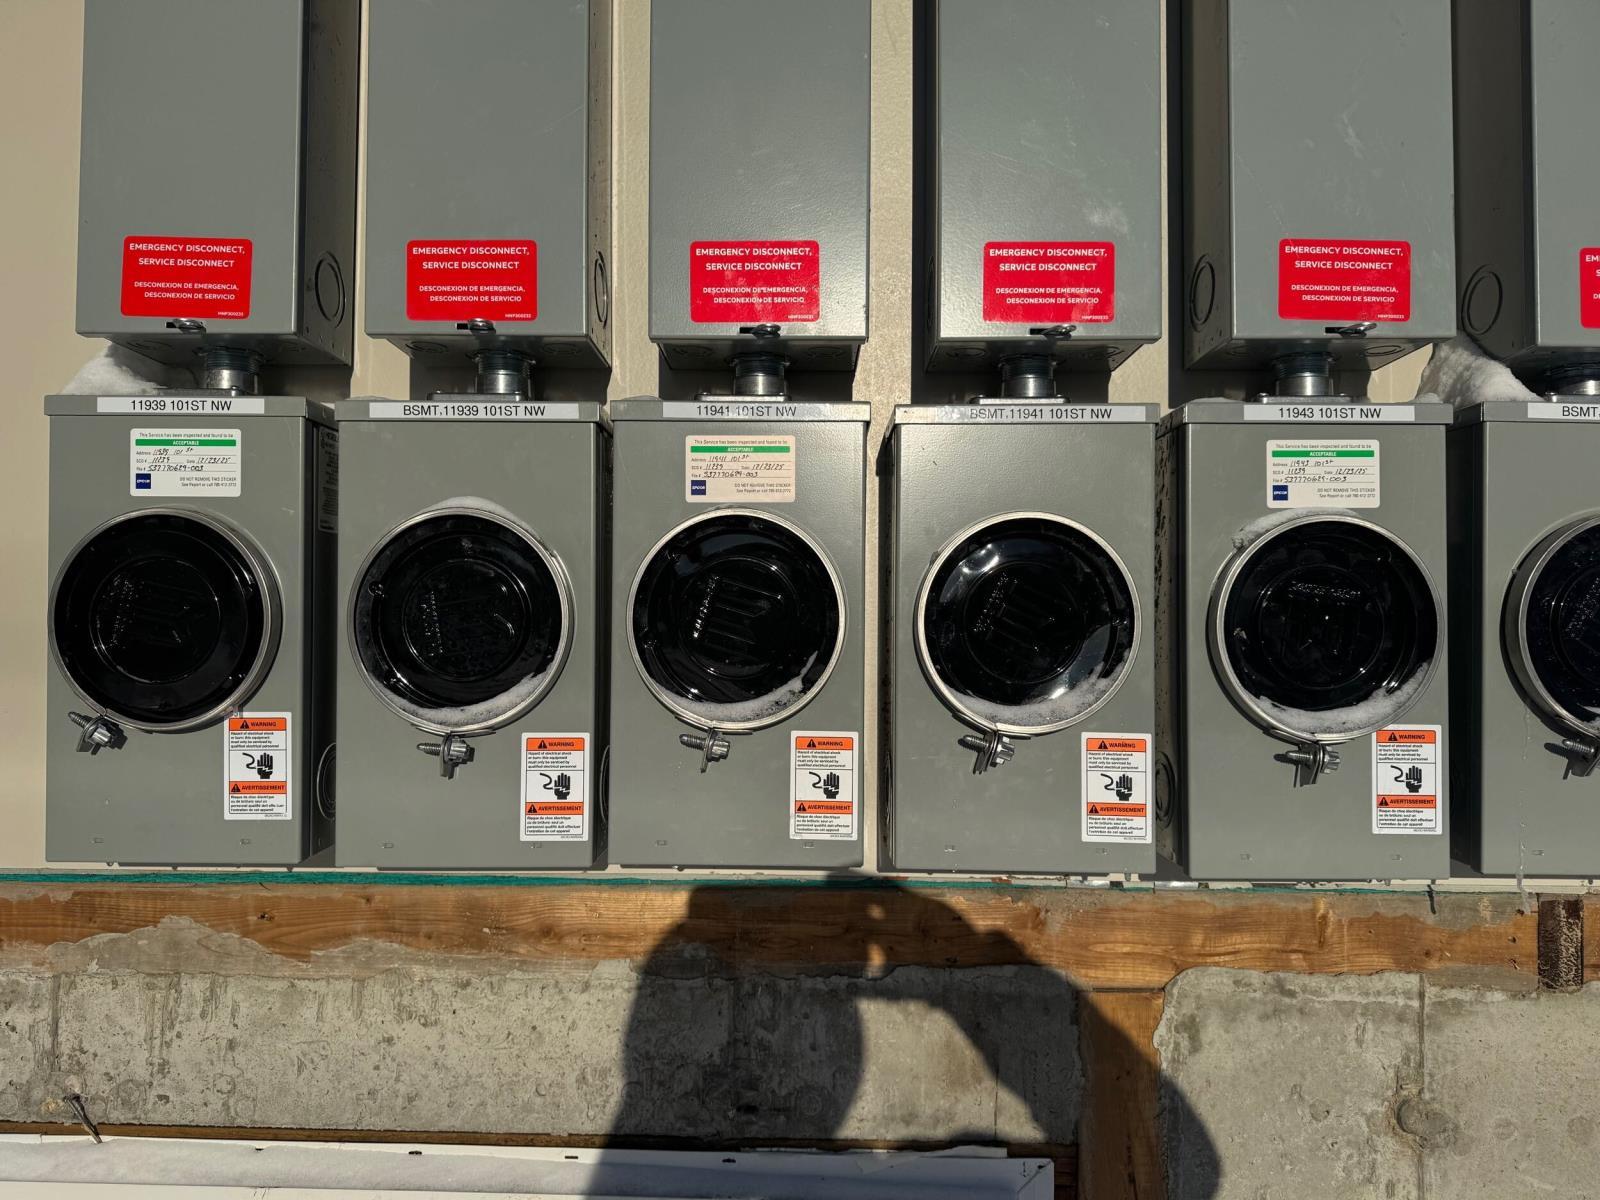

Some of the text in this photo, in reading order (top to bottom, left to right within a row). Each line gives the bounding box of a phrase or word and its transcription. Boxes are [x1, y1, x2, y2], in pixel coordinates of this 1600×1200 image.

[129, 243, 245, 255] EMERGENCY DISCONNECT,
[470, 247, 530, 256] DISCONNECT,
[752, 248, 812, 256] DISCONNECT,
[989, 249, 1108, 257] EMERGENCY DISCONNECT,
[1285, 246, 1404, 256] EMERGENCY DISCONNECT,
[138, 258, 235, 268] SERVICE DISCONNECT
[705, 262, 802, 271] SERVICE DISCONNECT
[999, 263, 1036, 271] SERVICE
[1295, 260, 1393, 270] SERVICE DISCONNECT
[130, 400, 232, 411] 11939 101ST NW
[483, 406, 520, 416] 101ST
[524, 406, 546, 416] NW
[696, 406, 797, 416] 11941 101ST NW
[1049, 408, 1086, 419] 101ST
[1090, 408, 1112, 419] NW
[1279, 407, 1382, 419] 11943 101ST NW
